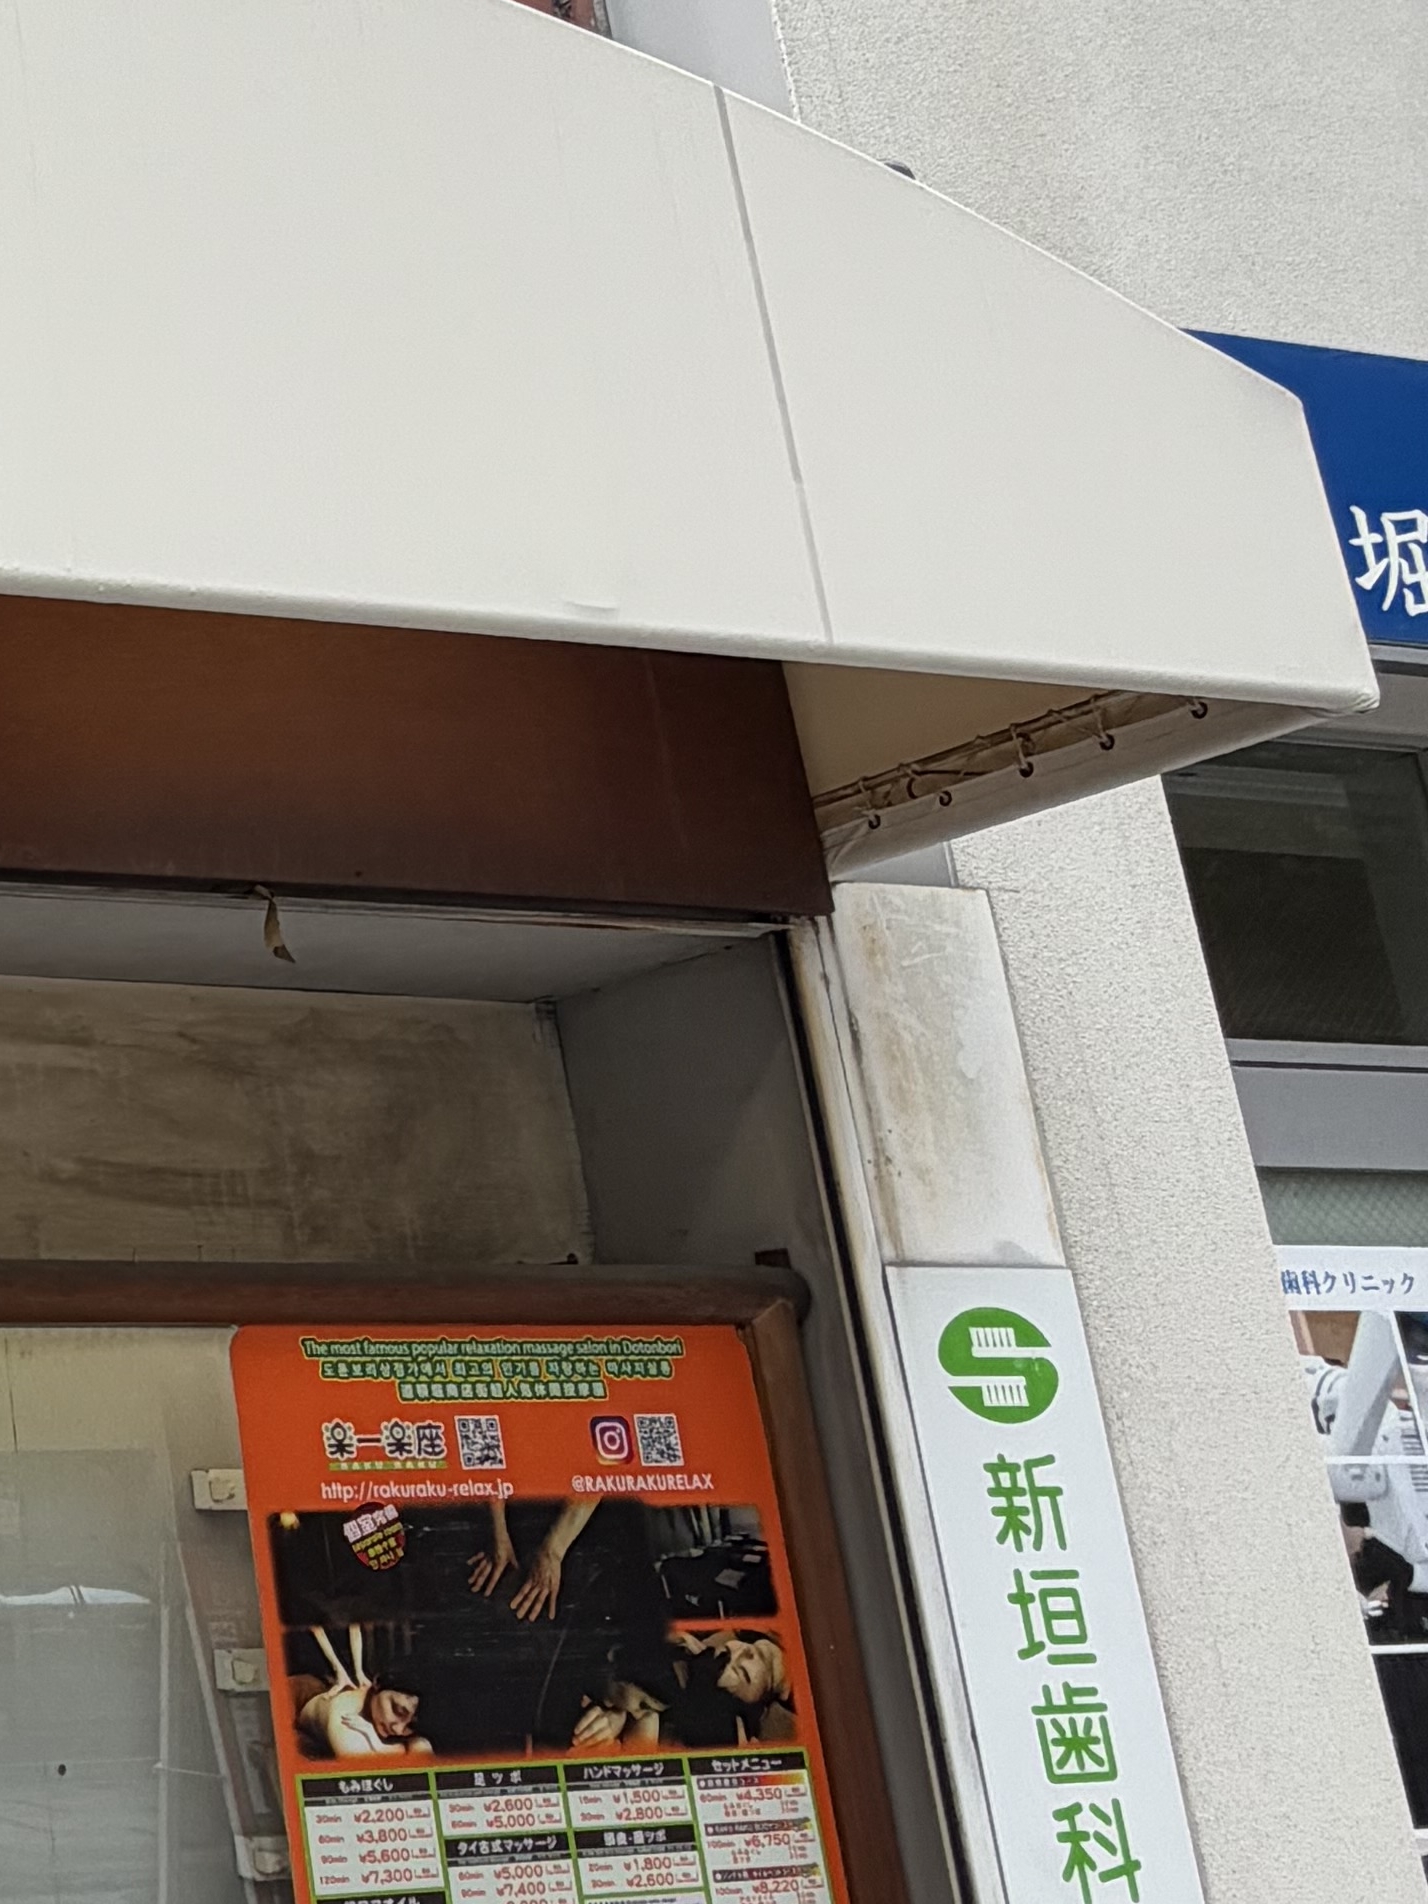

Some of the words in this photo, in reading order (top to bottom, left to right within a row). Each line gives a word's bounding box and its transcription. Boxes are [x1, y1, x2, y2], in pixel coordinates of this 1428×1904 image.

[1280, 1269, 1416, 1295] 歯科クリニック
[305, 1341, 329, 1355] The
[330, 1342, 362, 1355] most
[411, 1341, 459, 1358] popular
[460, 1341, 520, 1355] relaxation
[522, 1342, 574, 1358] massage
[575, 1341, 608, 1354] salon
[623, 1340, 682, 1354] Dotonbori
[321, 1479, 514, 1501] http://rakuraku-relax.jp
[571, 1472, 714, 1493] @RAKURAKURELAX
[583, 1762, 665, 1779] ハンドマッサージ
[710, 1757, 783, 1773] セットメニュー
[338, 1778, 394, 1794] もみほぐし
[457, 1834, 558, 1856] タイ古式マッサージ
